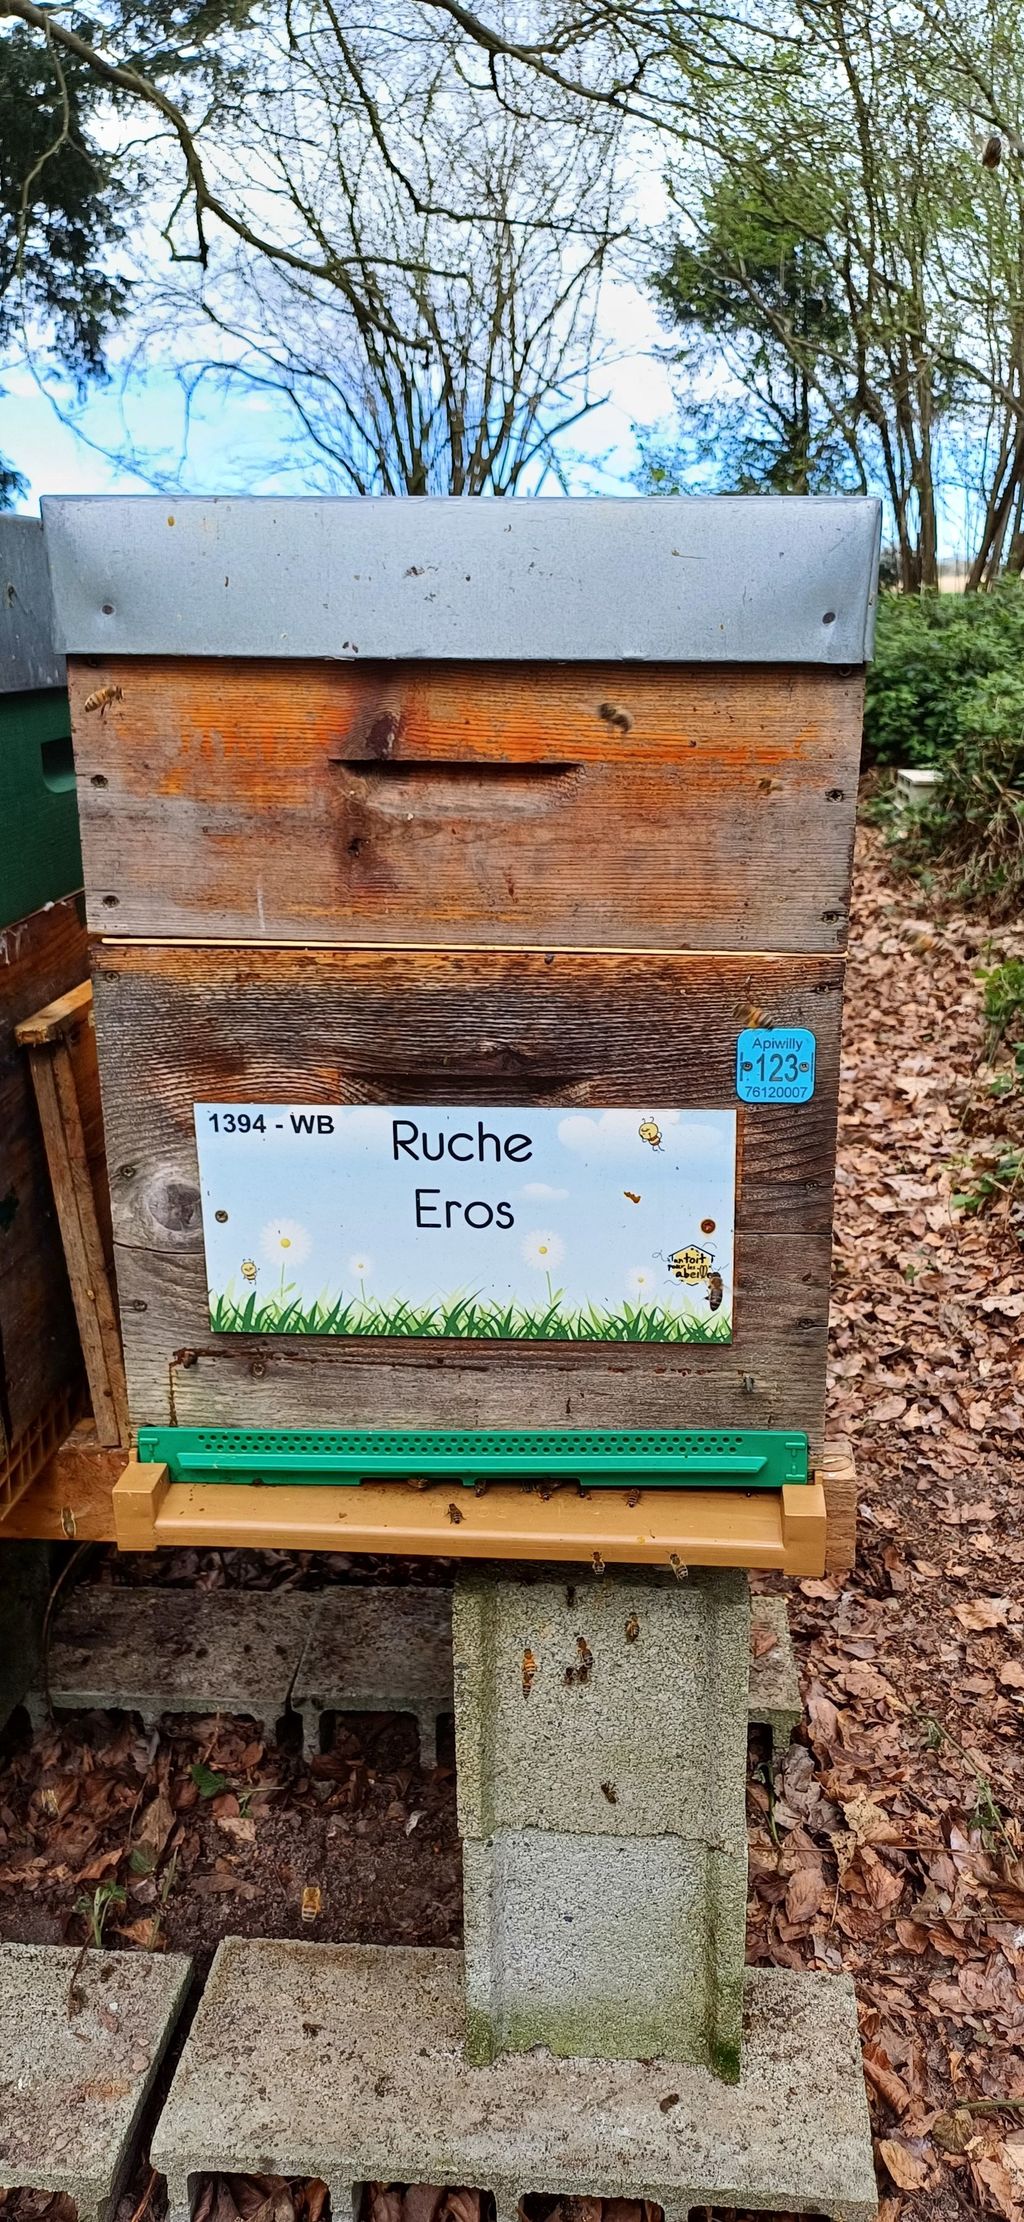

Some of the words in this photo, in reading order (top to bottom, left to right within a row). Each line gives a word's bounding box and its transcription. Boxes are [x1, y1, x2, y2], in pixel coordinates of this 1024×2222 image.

[752, 1037, 803, 1052] Apiwilly
[756, 1053, 799, 1082] 123
[745, 1086, 808, 1098] 76120007
[208, 1113, 267, 1134] 1394
[290, 1114, 335, 1135] WB
[392, 1120, 533, 1163] Ruche
[415, 1188, 515, 1230] Eros
[684, 1252, 707, 1264] toit
